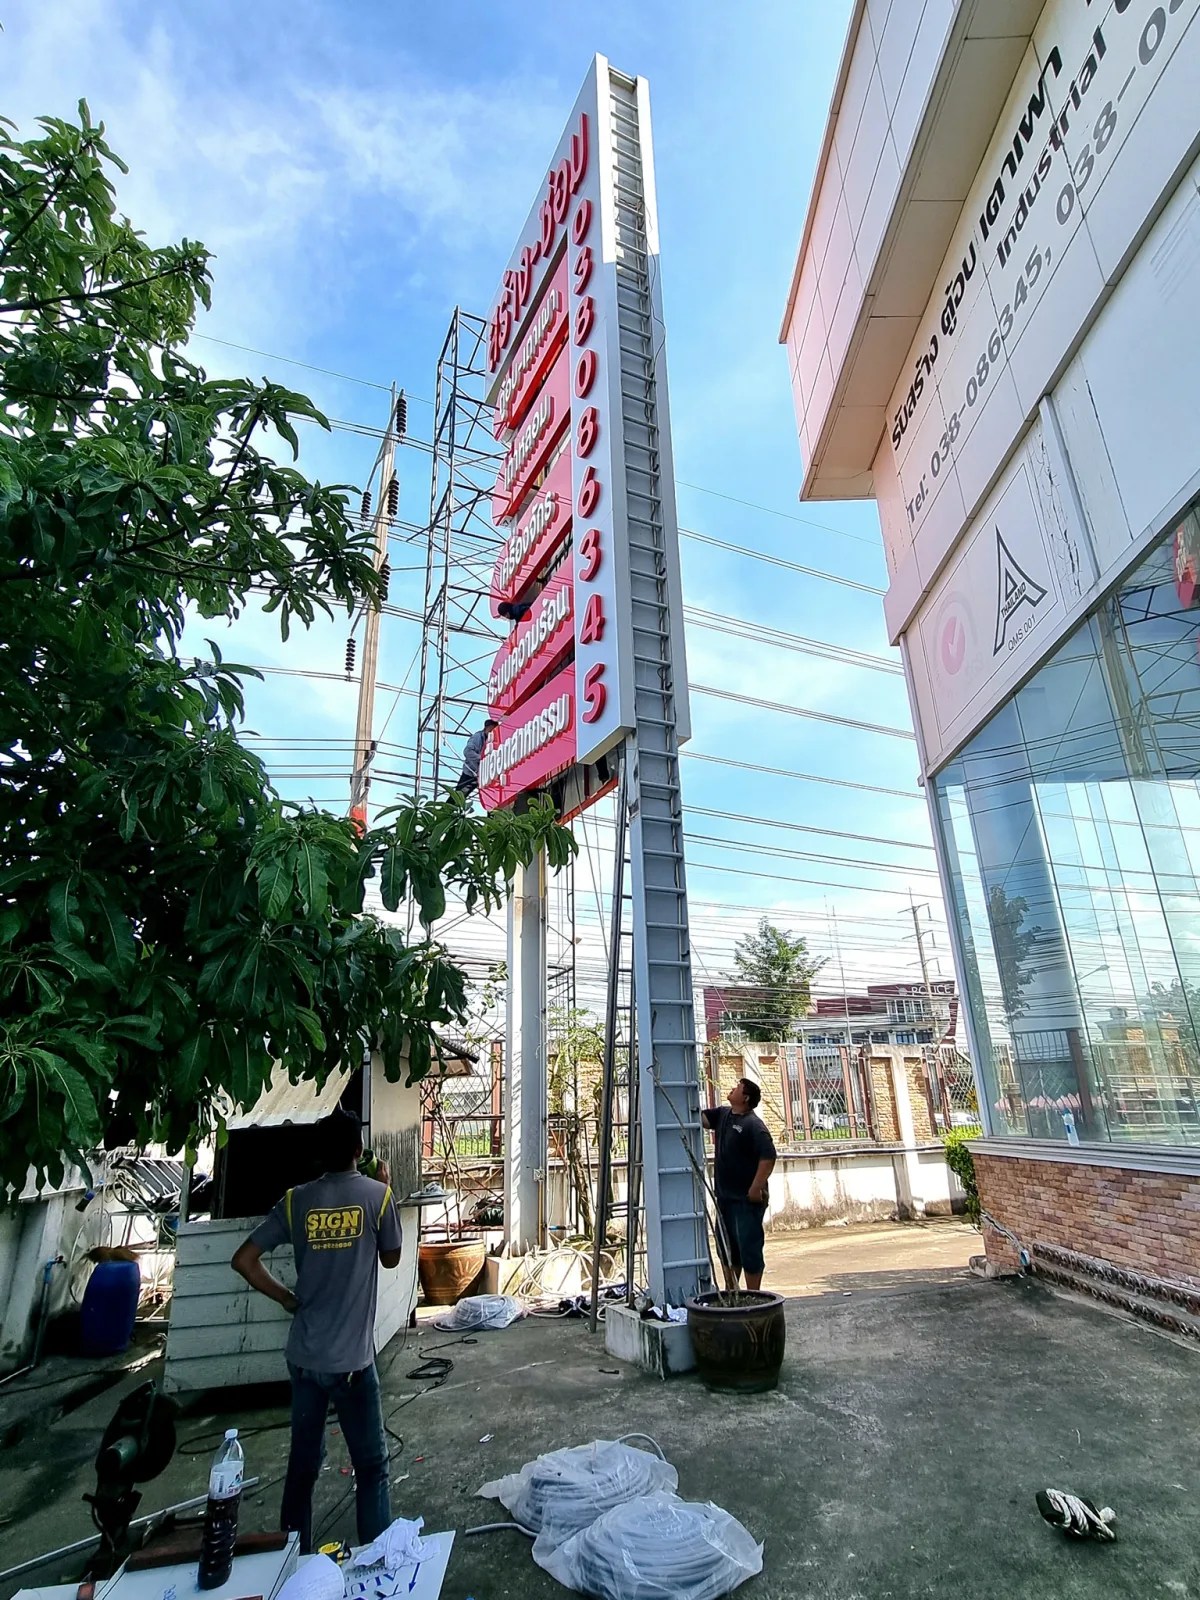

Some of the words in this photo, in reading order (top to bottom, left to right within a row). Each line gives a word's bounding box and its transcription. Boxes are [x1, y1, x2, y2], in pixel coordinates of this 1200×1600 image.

[996, 25, 1107, 269] Industrial
[891, 335, 938, 452] รับสร้าง
[940, 243, 977, 337] ตู้อบ
[978, 45, 1063, 243] เตาเผา
[906, 473, 931, 524] Tel:
[929, 245, 1053, 480] 038-086345,
[1001, 582, 1027, 618] THAILAND
[1007, 628, 1024, 651] QMS
[1023, 613, 1037, 633] 001
[307, 1210, 360, 1231] SIGN
[308, 1228, 357, 1239] MAKER
